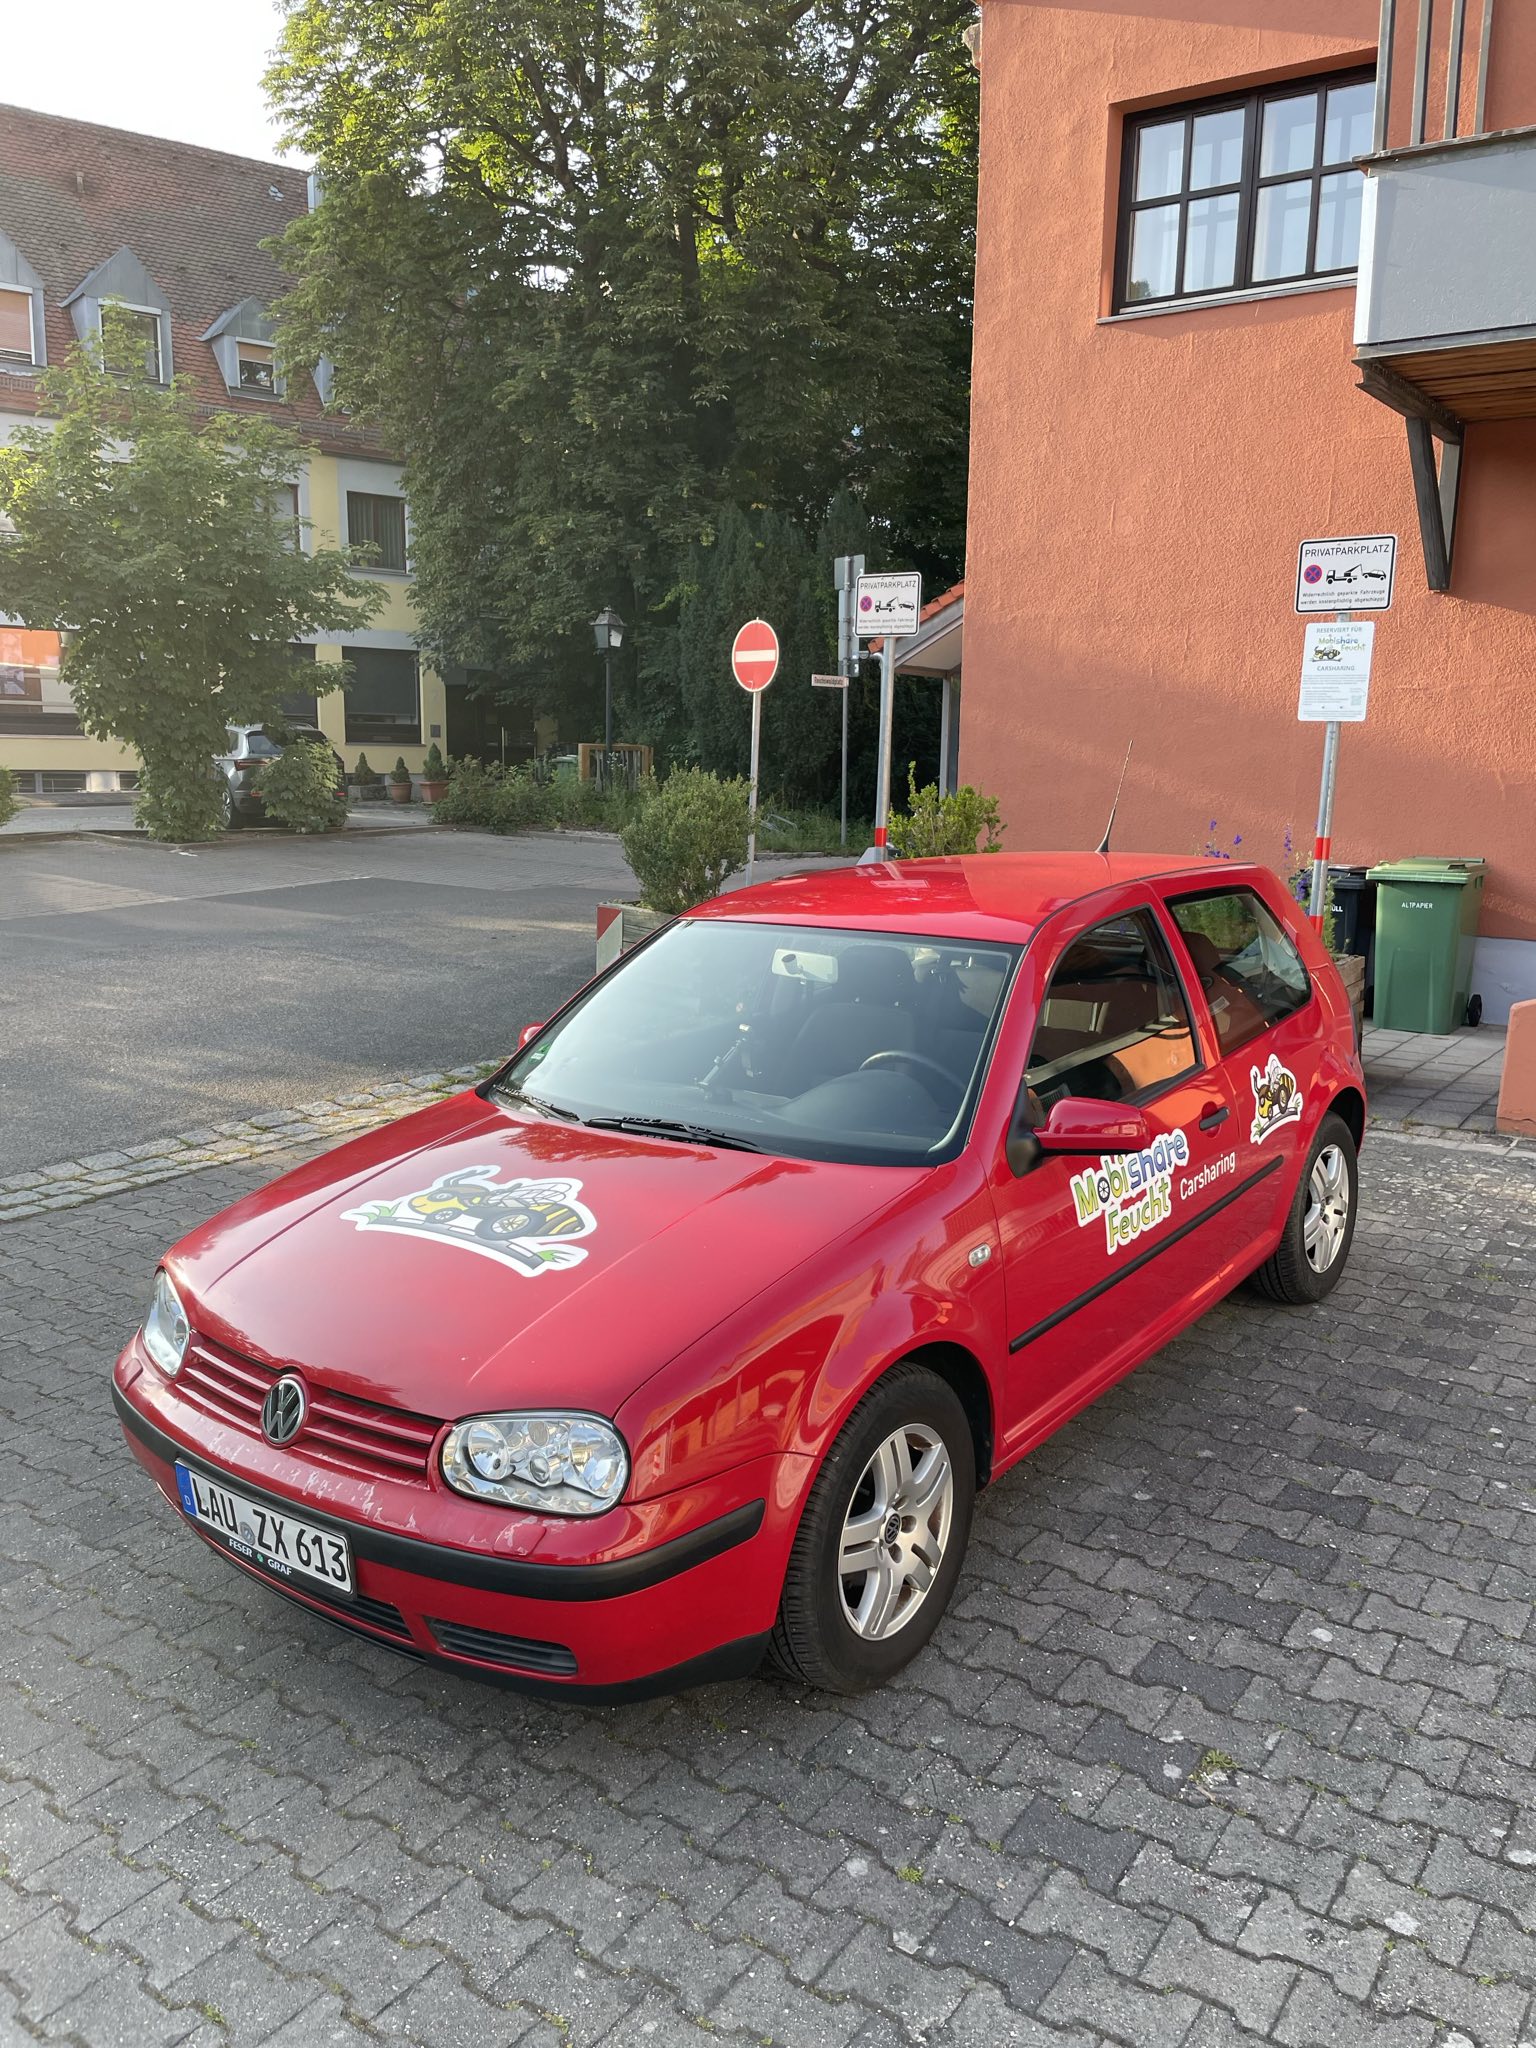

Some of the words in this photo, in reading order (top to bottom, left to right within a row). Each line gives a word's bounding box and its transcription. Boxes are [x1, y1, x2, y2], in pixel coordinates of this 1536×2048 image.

[1304, 544, 1390, 558] PRIVATPARKPLATZ
[860, 580, 917, 590] PRIVATPARKPLATZ
[1351, 625, 1363, 633] FÜR
[1318, 636, 1358, 645] Mobishare
[1340, 643, 1366, 652] Feucht
[1401, 901, 1434, 910] ALTPAPIER
[1073, 1132, 1187, 1220] Mobishare
[1179, 1152, 1236, 1200] Carsharing
[1107, 1177, 1170, 1249] Feucht
[184, 1494, 192, 1506] D
[191, 1477, 239, 1535] LAU
[252, 1508, 290, 1560] ZX
[296, 1528, 348, 1583] 613
[228, 1538, 253, 1558] FESER
[267, 1558, 293, 1576] GRAF
